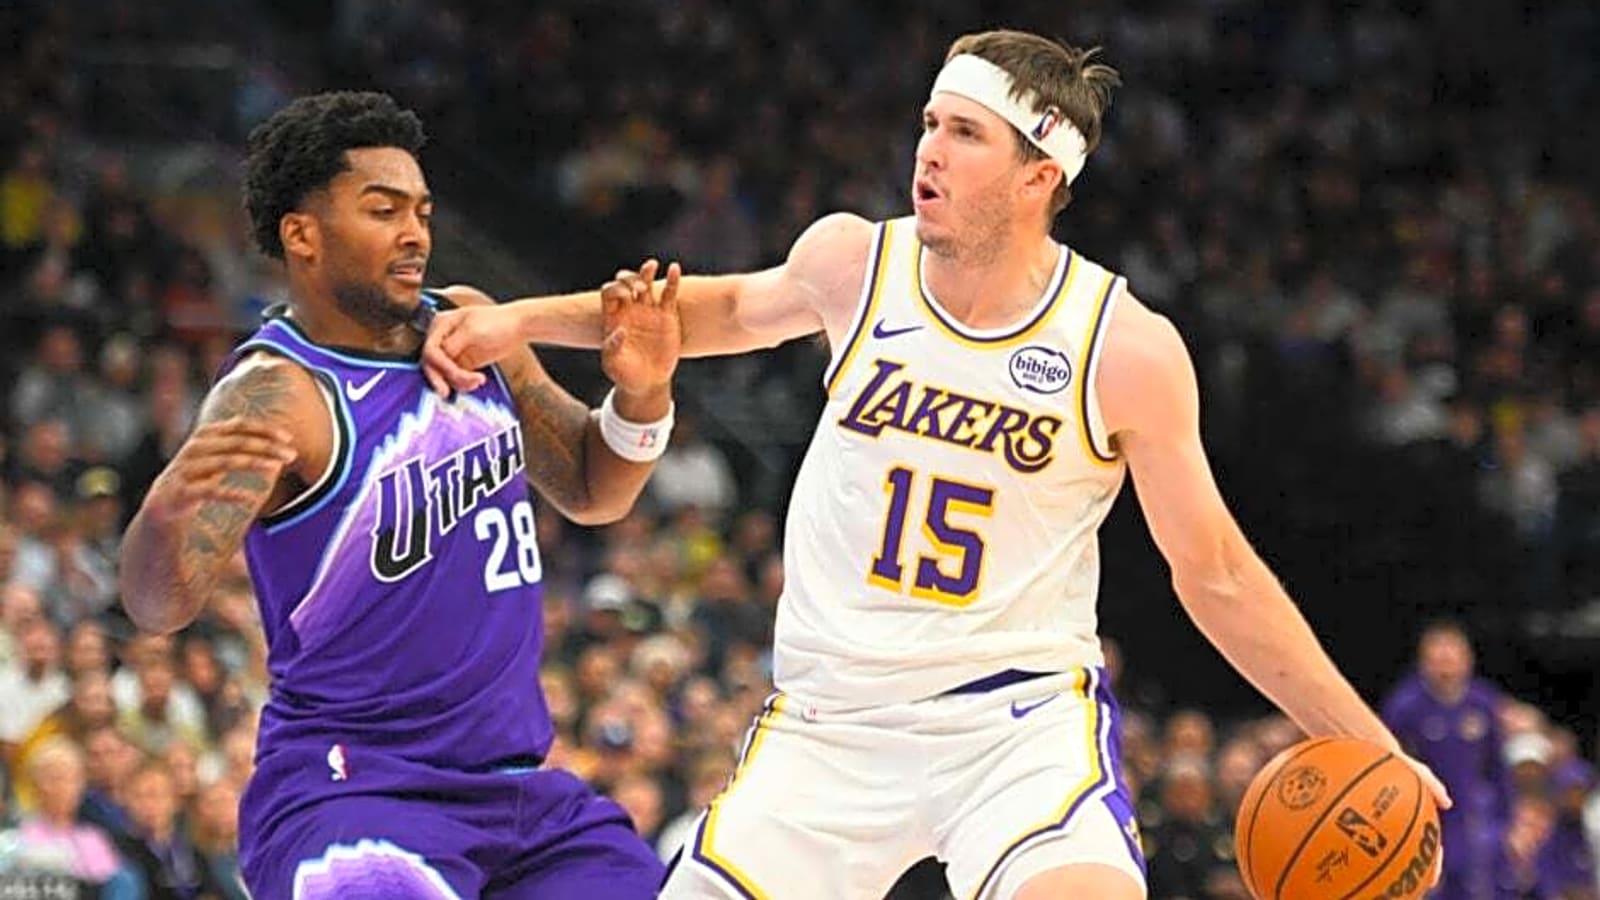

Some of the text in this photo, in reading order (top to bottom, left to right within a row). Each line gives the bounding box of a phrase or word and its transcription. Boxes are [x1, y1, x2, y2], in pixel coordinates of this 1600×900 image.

[838, 358, 1062, 473] LAKERS
[1015, 355, 1068, 383] bibigo
[370, 420, 526, 582] UTAH
[475, 501, 542, 593] 28
[868, 464, 995, 607] 15
[1376, 821, 1438, 900] Wilso
